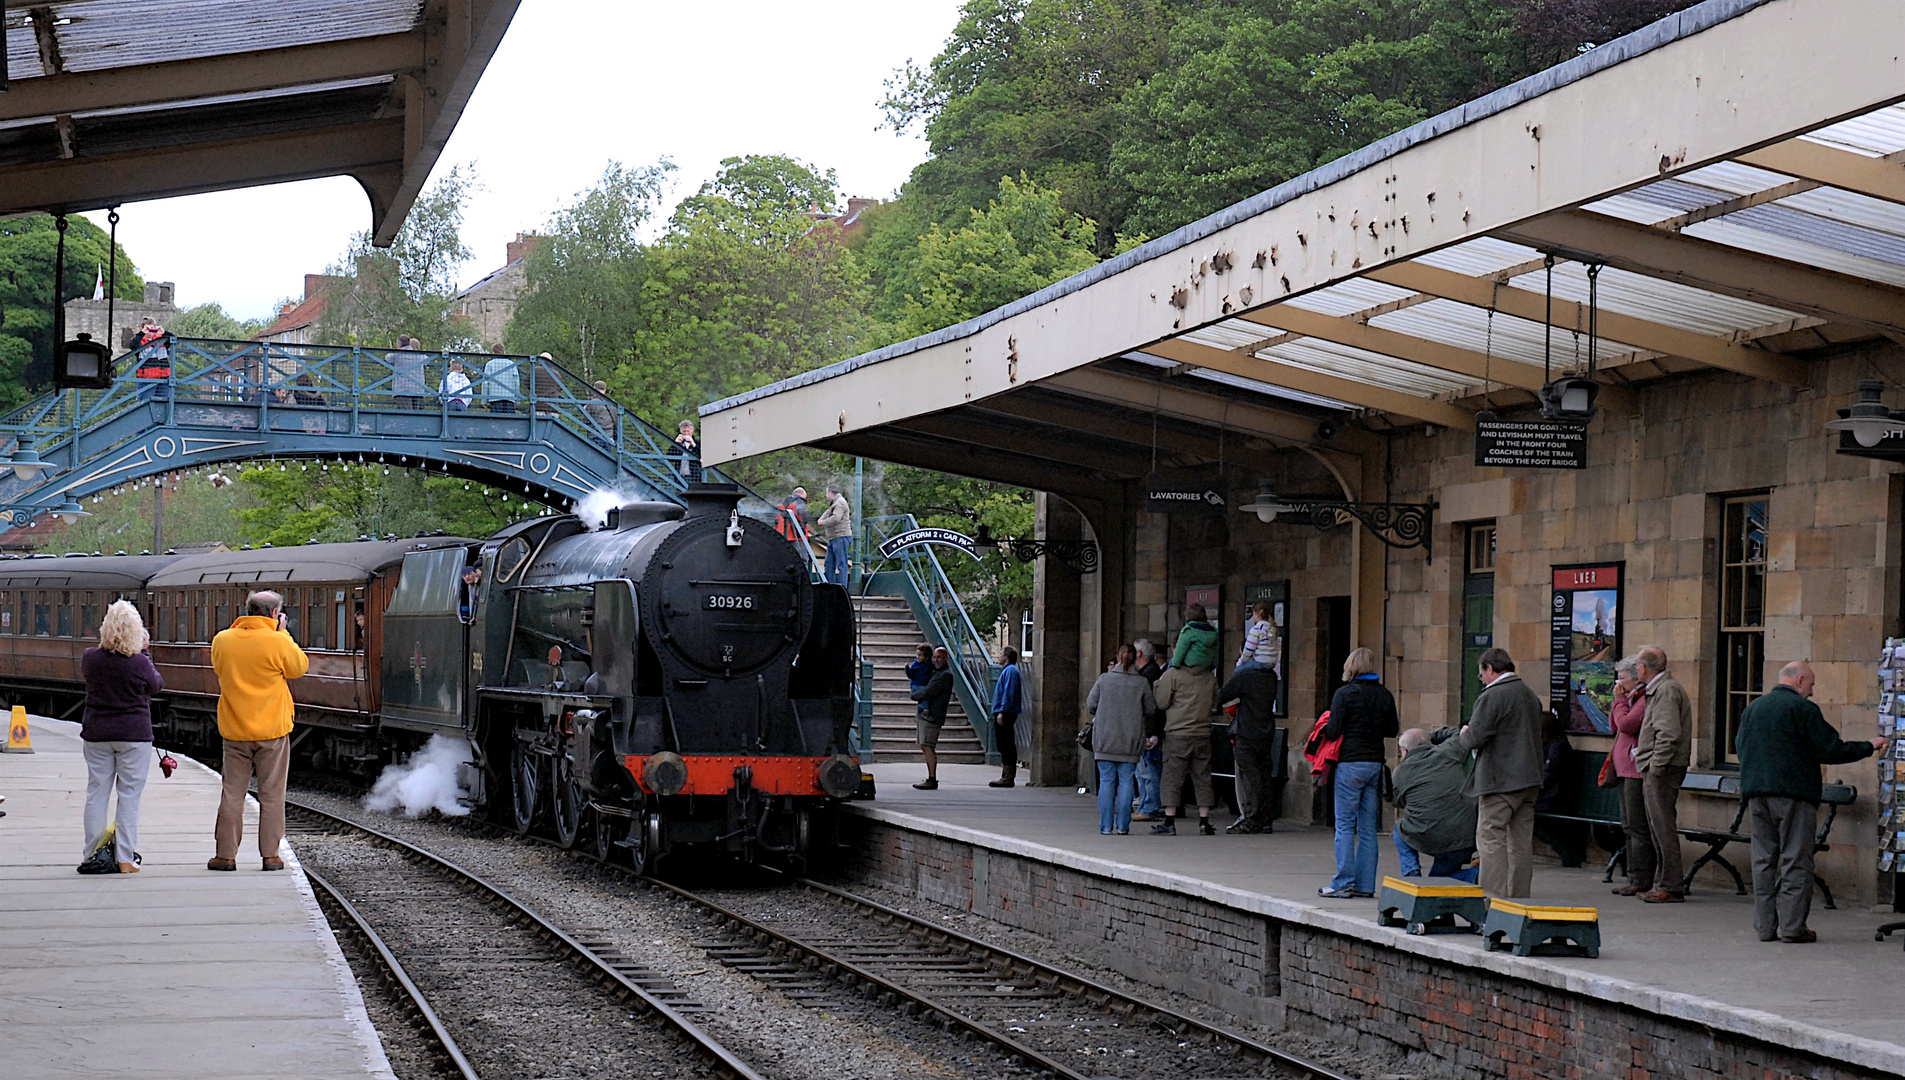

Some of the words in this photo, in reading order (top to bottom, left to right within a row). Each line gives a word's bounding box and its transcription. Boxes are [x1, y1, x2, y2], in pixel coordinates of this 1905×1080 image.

[1479, 422, 1523, 430] PASSENGERS
[1498, 431, 1534, 439] LEVISHAM
[1489, 448, 1523, 456] COACHES
[1150, 491, 1201, 500] LAVATORIES
[897, 531, 932, 546] PLATFORM
[943, 532, 958, 542] CAR
[958, 538, 974, 552] PAR
[1574, 571, 1596, 584] LNER
[709, 595, 752, 608] 30926
